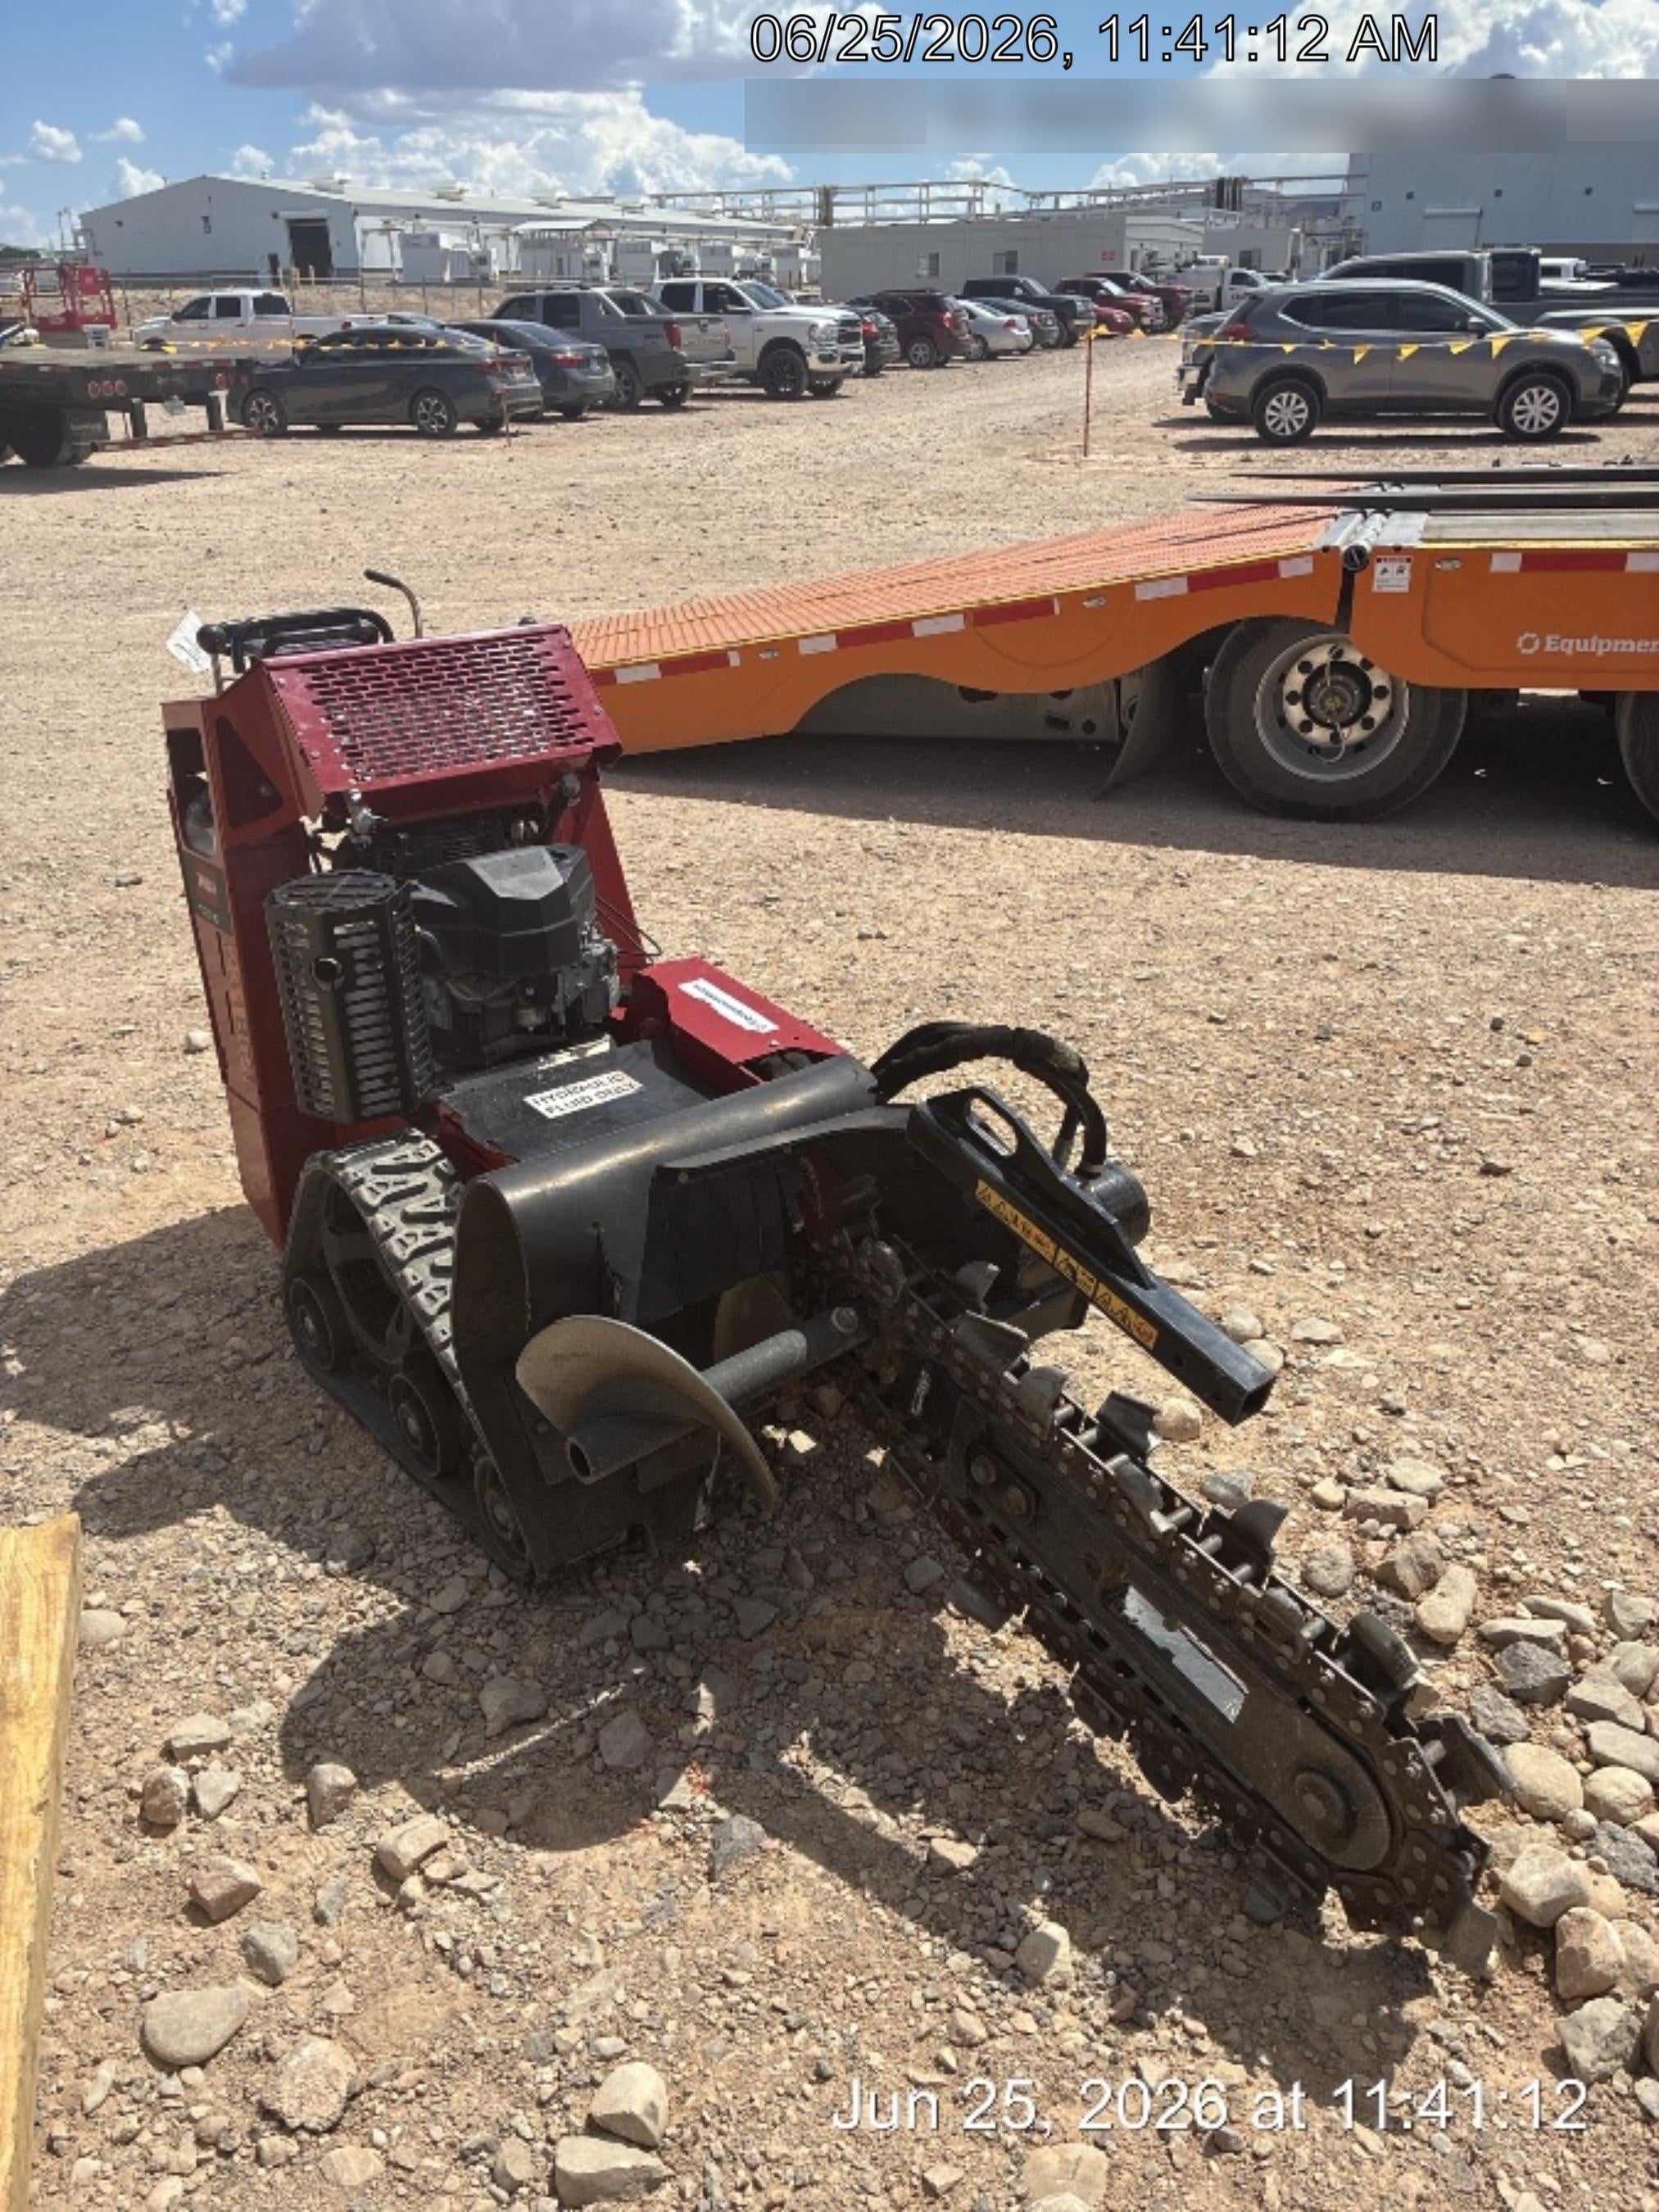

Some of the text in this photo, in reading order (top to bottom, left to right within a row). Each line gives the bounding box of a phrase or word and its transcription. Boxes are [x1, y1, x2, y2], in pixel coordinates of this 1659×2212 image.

[531, 1072, 626, 1107] HYDRAULIC
[545, 1081, 637, 1114] FLUID ONLY
